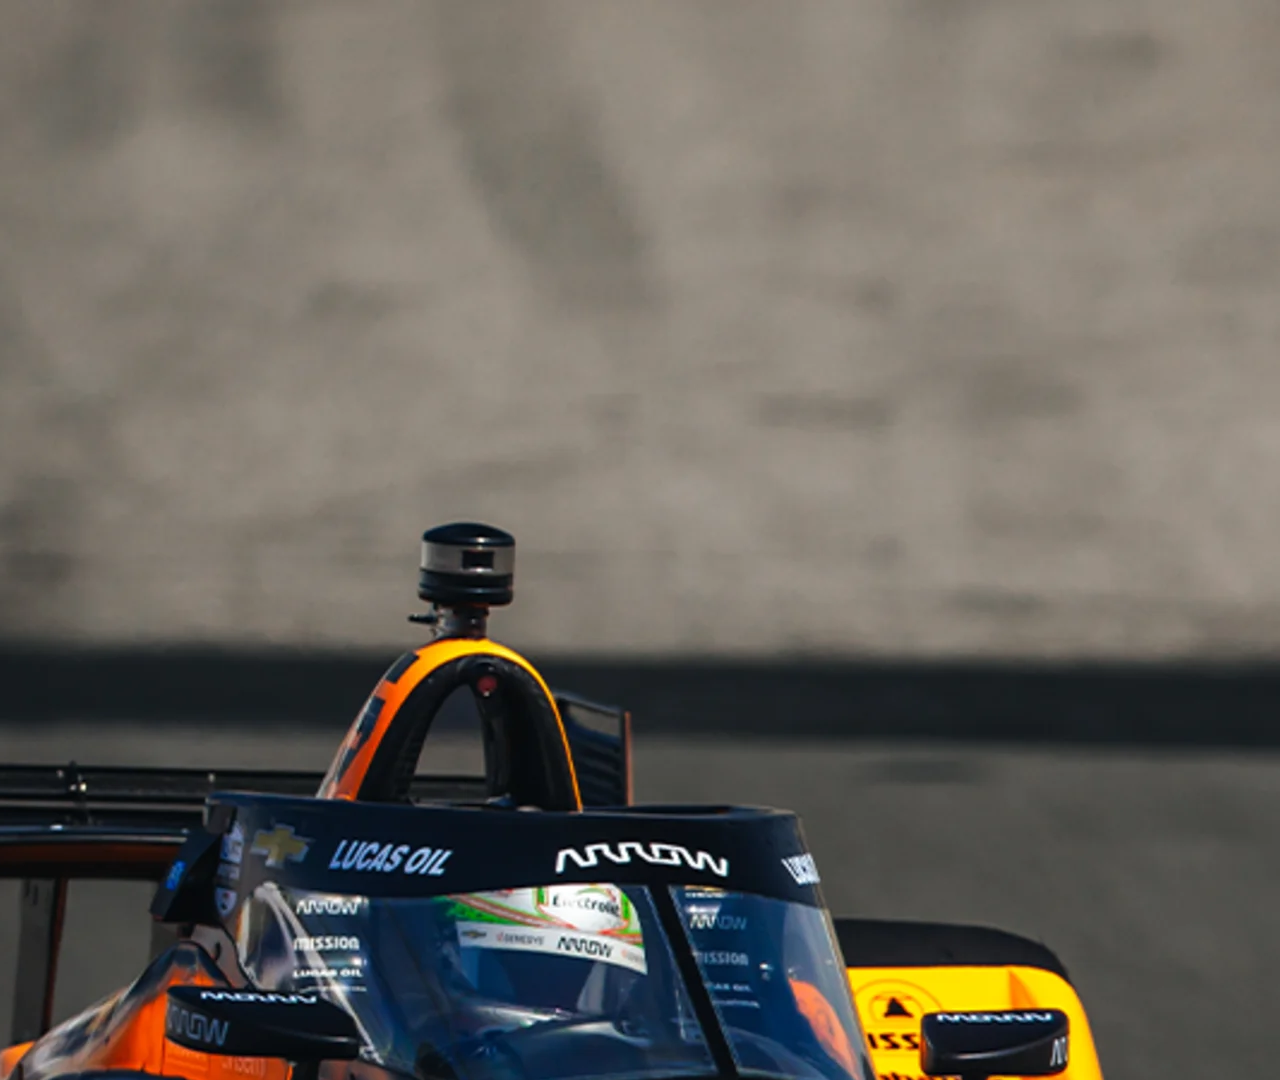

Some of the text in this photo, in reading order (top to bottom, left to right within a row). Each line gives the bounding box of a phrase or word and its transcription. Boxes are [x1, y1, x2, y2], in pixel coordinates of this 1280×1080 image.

[328, 838, 455, 877] LUCAS OIL
[555, 841, 729, 877] ARROW
